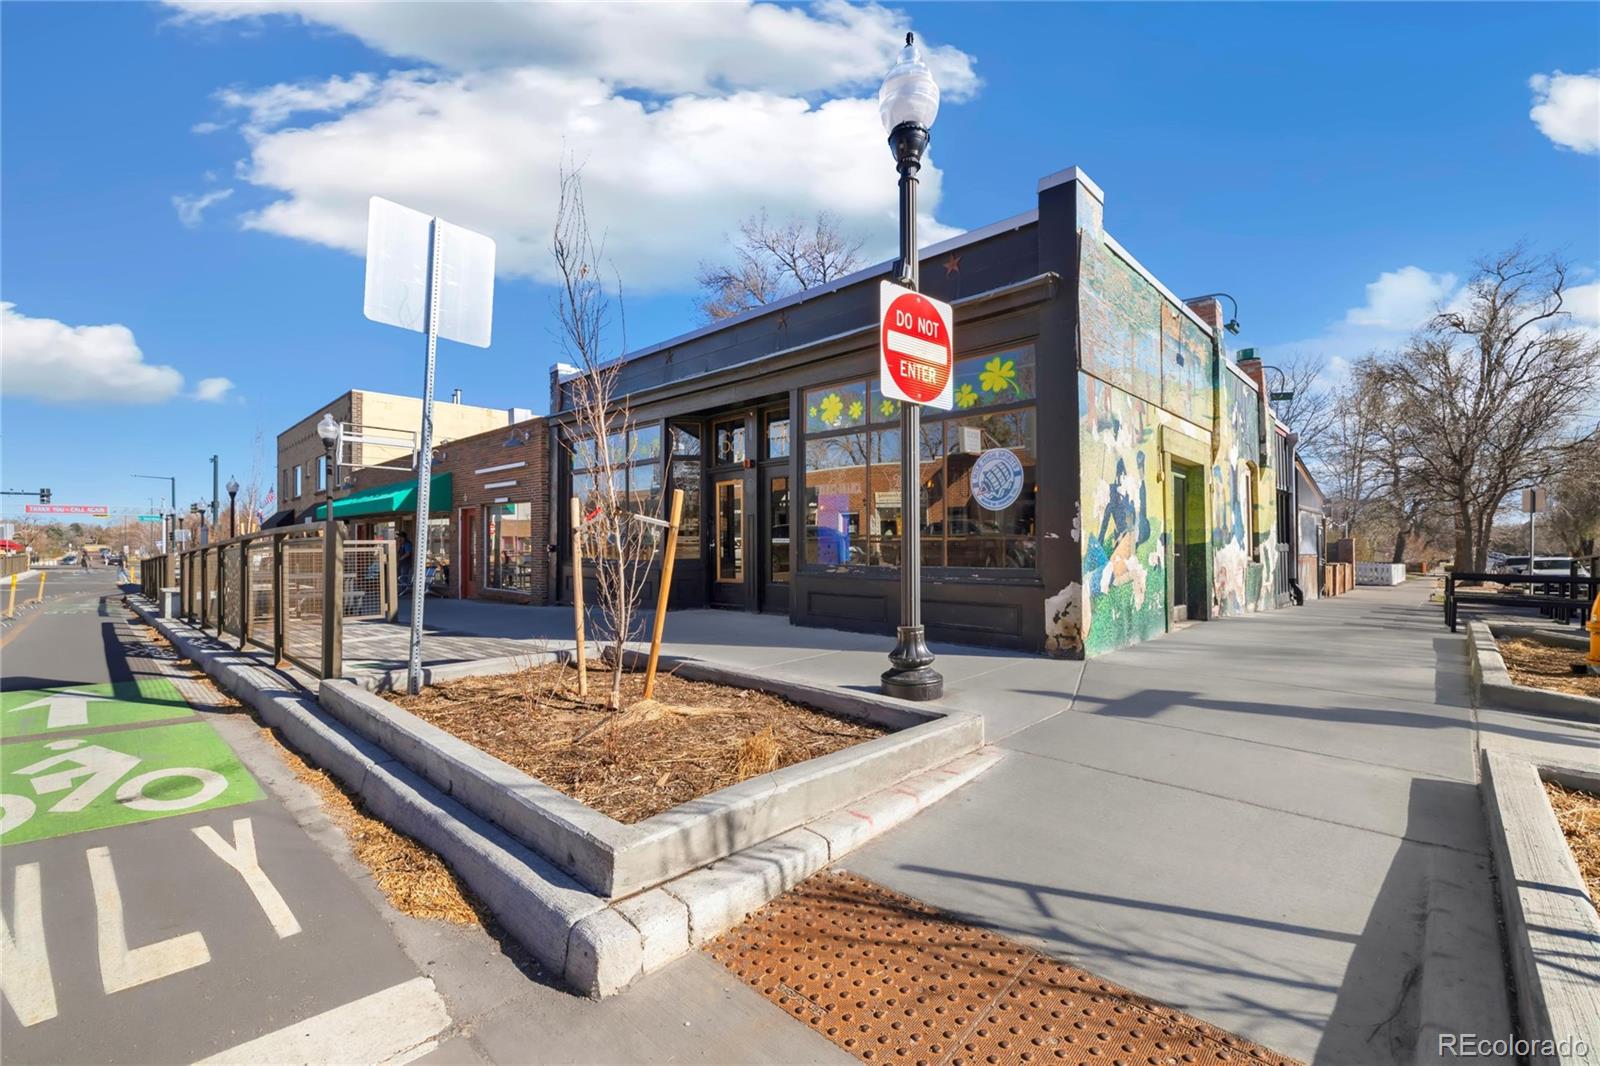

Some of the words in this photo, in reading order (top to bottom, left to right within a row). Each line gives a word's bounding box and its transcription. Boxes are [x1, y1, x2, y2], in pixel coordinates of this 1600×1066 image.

[895, 309, 913, 330] DO
[917, 316, 939, 339] NOT
[900, 359, 937, 385] ENTER
